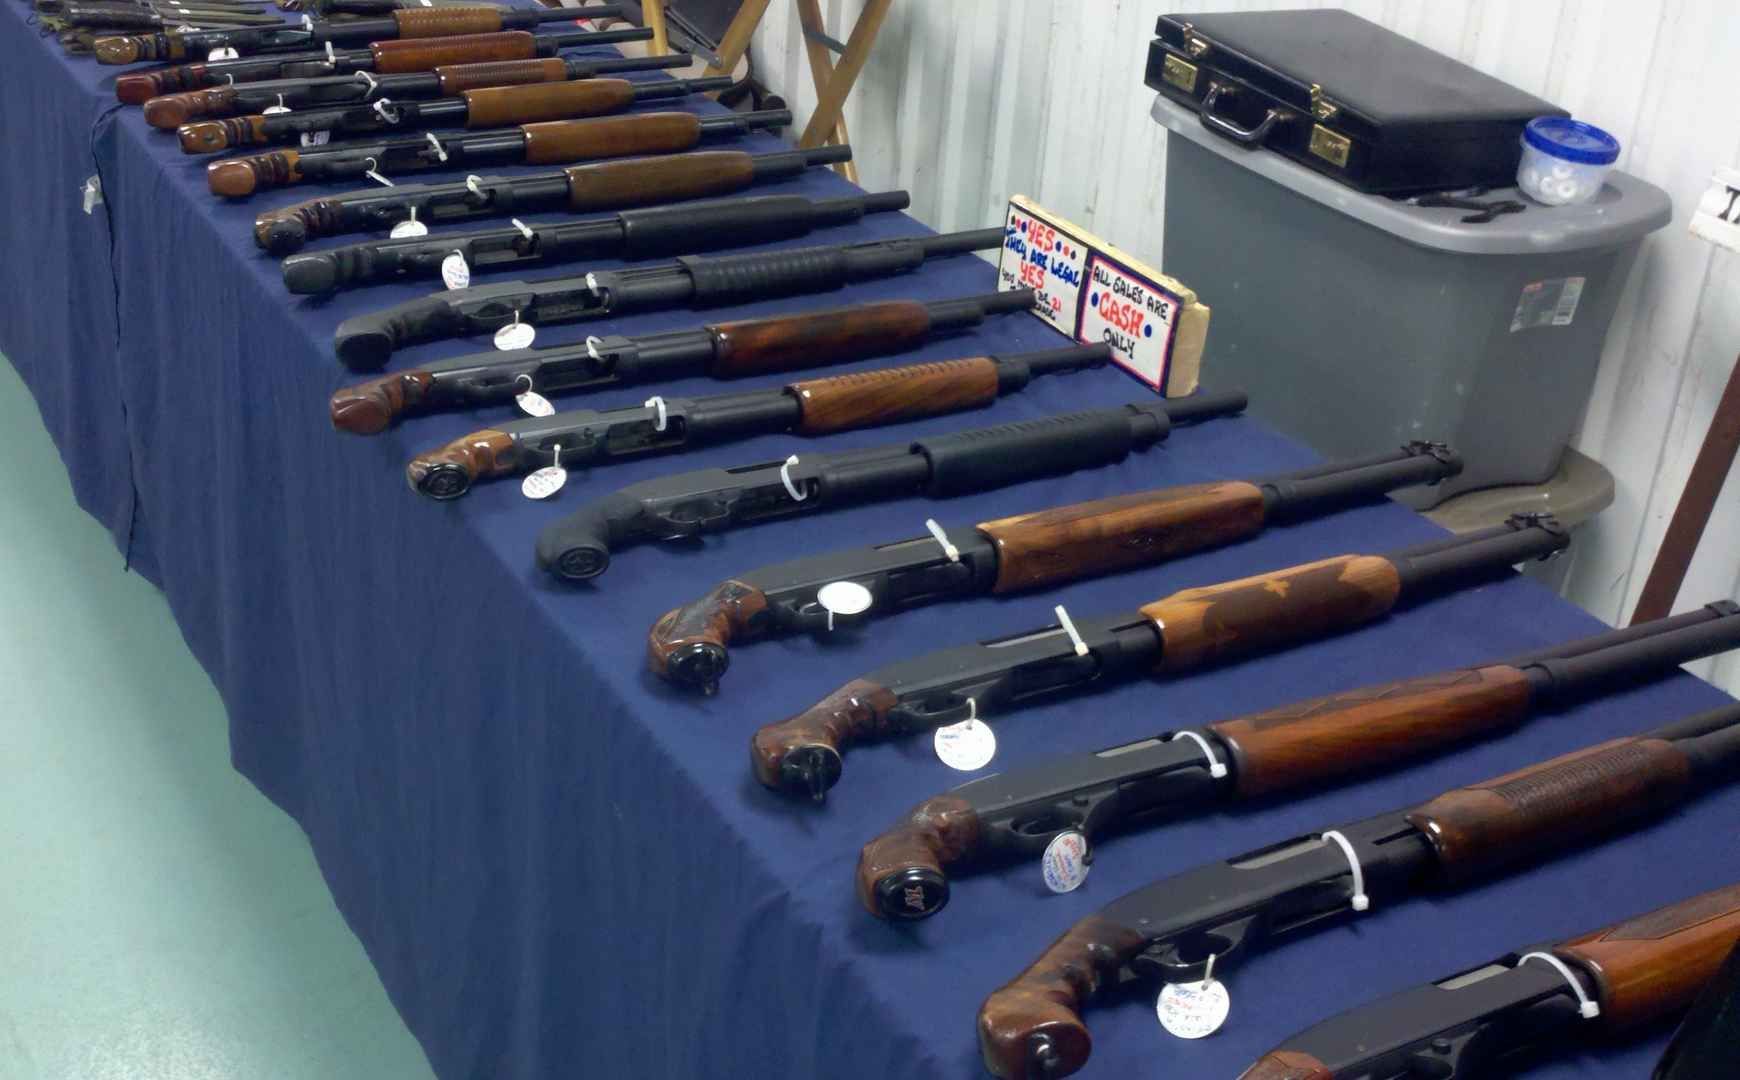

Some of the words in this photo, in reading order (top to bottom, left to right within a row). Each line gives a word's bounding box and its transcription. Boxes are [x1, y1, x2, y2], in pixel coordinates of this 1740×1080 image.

[1028, 219, 1055, 252] YES
[1021, 261, 1044, 289] YES
[1030, 248, 1048, 271] ARE
[1051, 256, 1079, 288] LEGAL
[1051, 297, 1062, 312] 21
[1092, 265, 1111, 287] ALL
[1113, 276, 1144, 305] SALES
[1147, 295, 1168, 320] ARE
[1100, 292, 1144, 338] CASH
[1103, 327, 1135, 360] ONLY
